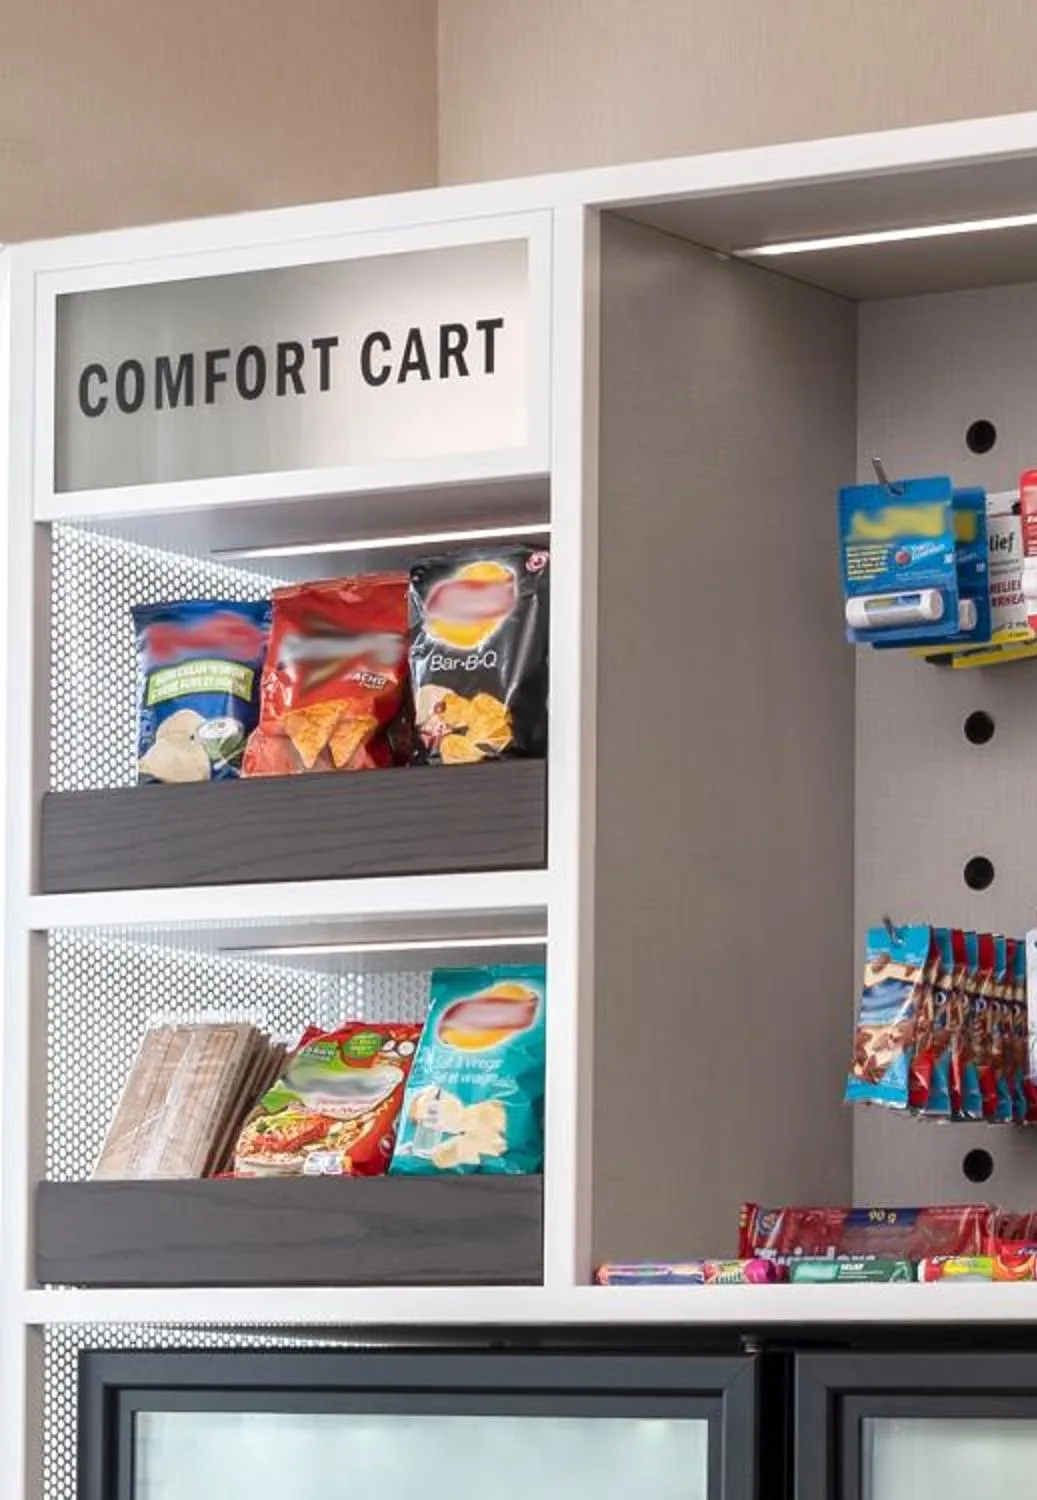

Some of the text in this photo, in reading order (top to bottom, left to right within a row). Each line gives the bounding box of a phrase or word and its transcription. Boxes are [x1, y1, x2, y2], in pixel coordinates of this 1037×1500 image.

[78, 317, 504, 418] COMFORT CART
[989, 532, 1015, 553] lief
